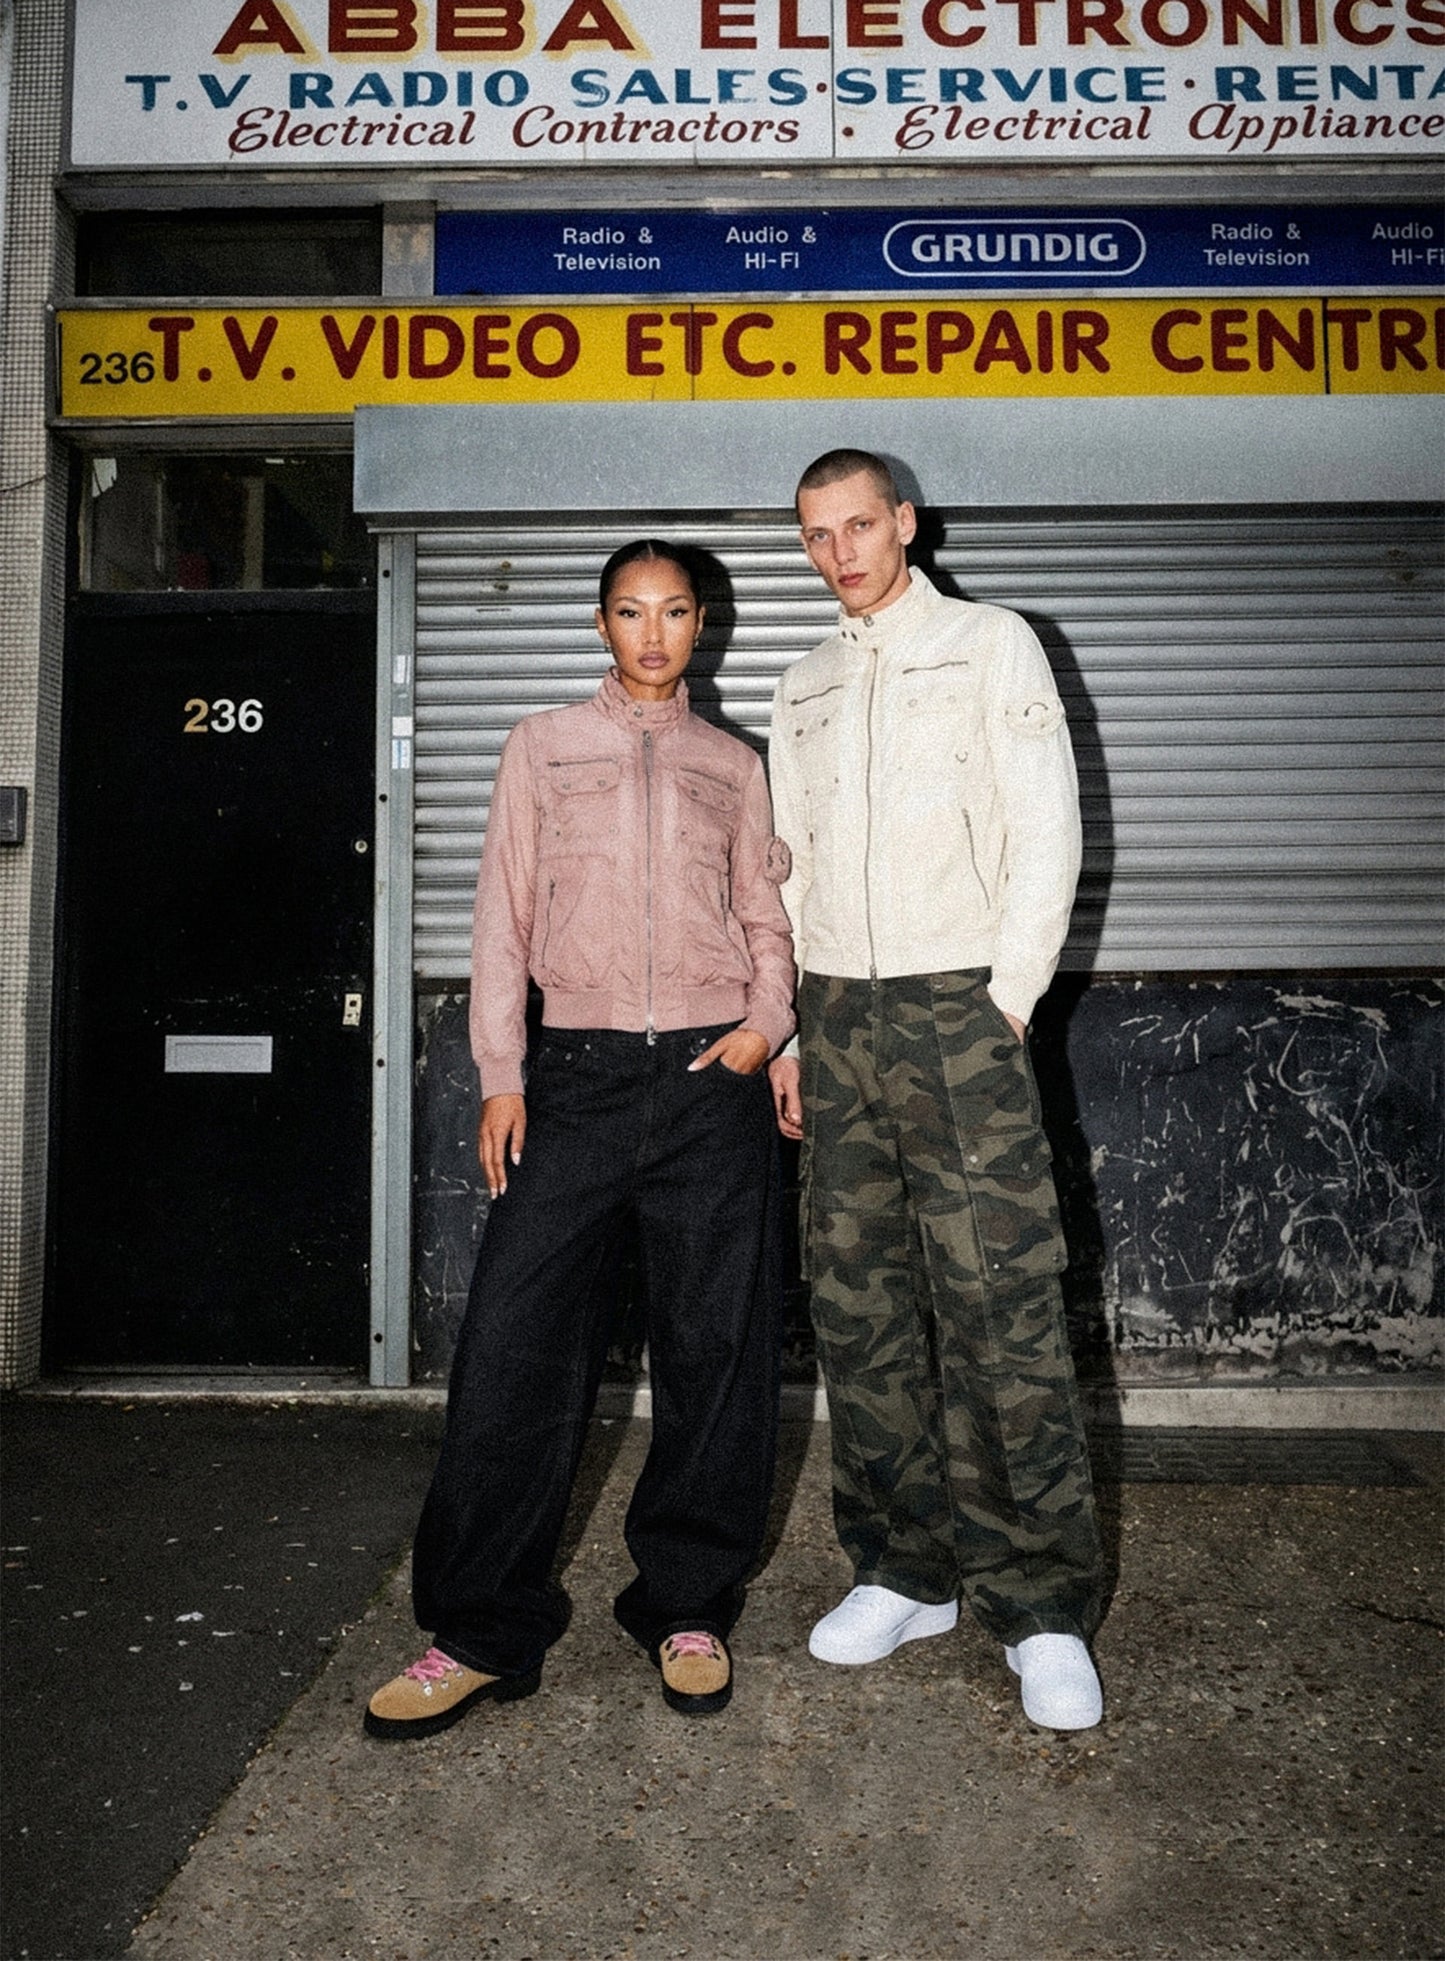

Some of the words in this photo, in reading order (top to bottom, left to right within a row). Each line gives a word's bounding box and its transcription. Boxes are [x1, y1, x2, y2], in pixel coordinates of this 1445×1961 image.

[213, 0, 640, 57] ABBA
[700, 0, 1445, 49] ELECTRONICS
[289, 70, 529, 108] RADIO
[571, 69, 808, 107] SALES
[836, 66, 1166, 104] SERVICE
[228, 107, 476, 153] Electrical
[512, 105, 799, 148] Contractors
[895, 105, 1152, 150] Electrical
[1188, 103, 1445, 152] Appliance
[563, 227, 625, 244] Radio
[638, 226, 654, 244] &
[725, 226, 789, 243] Audio
[801, 226, 817, 243] &
[1211, 223, 1273, 240] Radio
[1286, 223, 1301, 240] &
[1371, 222, 1434, 240] Audio
[553, 253, 661, 270] Television
[911, 233, 1119, 263] GRUNDIG
[1203, 249, 1310, 266] Television
[320, 313, 581, 380] VIDEO
[625, 312, 797, 377] ETC.
[824, 309, 1111, 376] REPAIR
[1151, 307, 1445, 374] CENTR
[79, 352, 155, 385] 236
[183, 698, 264, 733] 236
